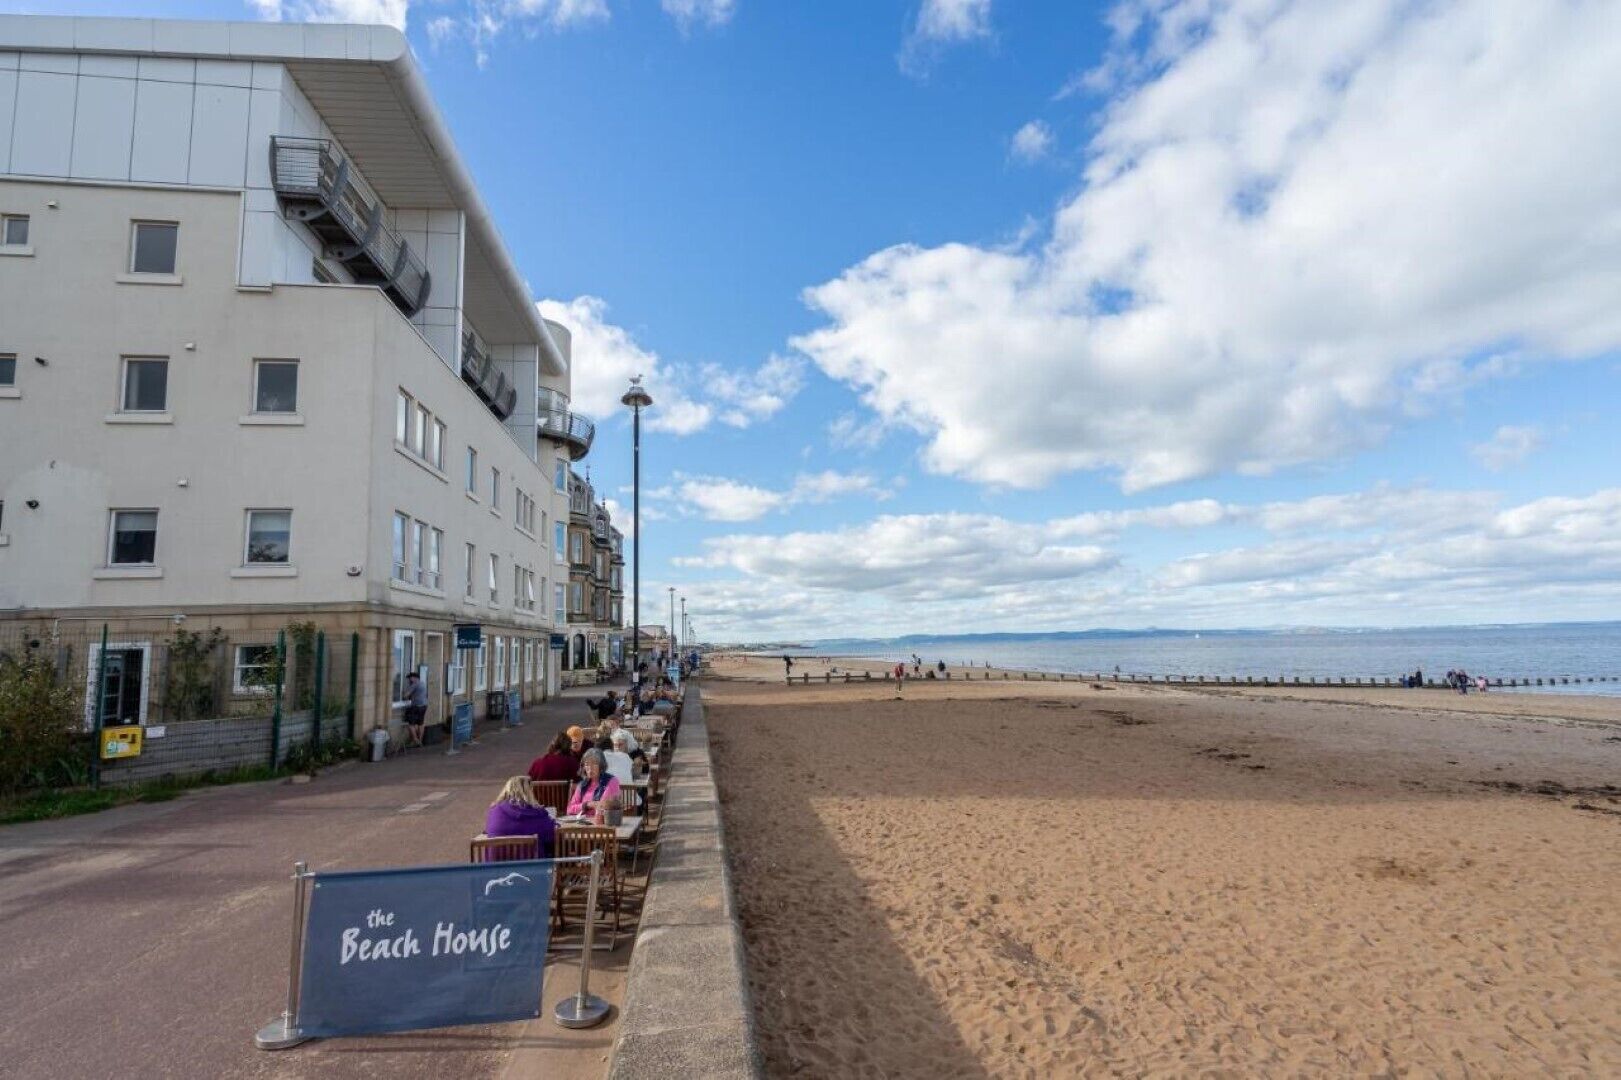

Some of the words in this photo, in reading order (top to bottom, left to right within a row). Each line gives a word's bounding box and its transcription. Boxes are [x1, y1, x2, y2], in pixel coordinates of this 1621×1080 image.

[366, 909, 395, 928] the
[340, 927, 421, 965] Beach
[432, 921, 511, 957] House
